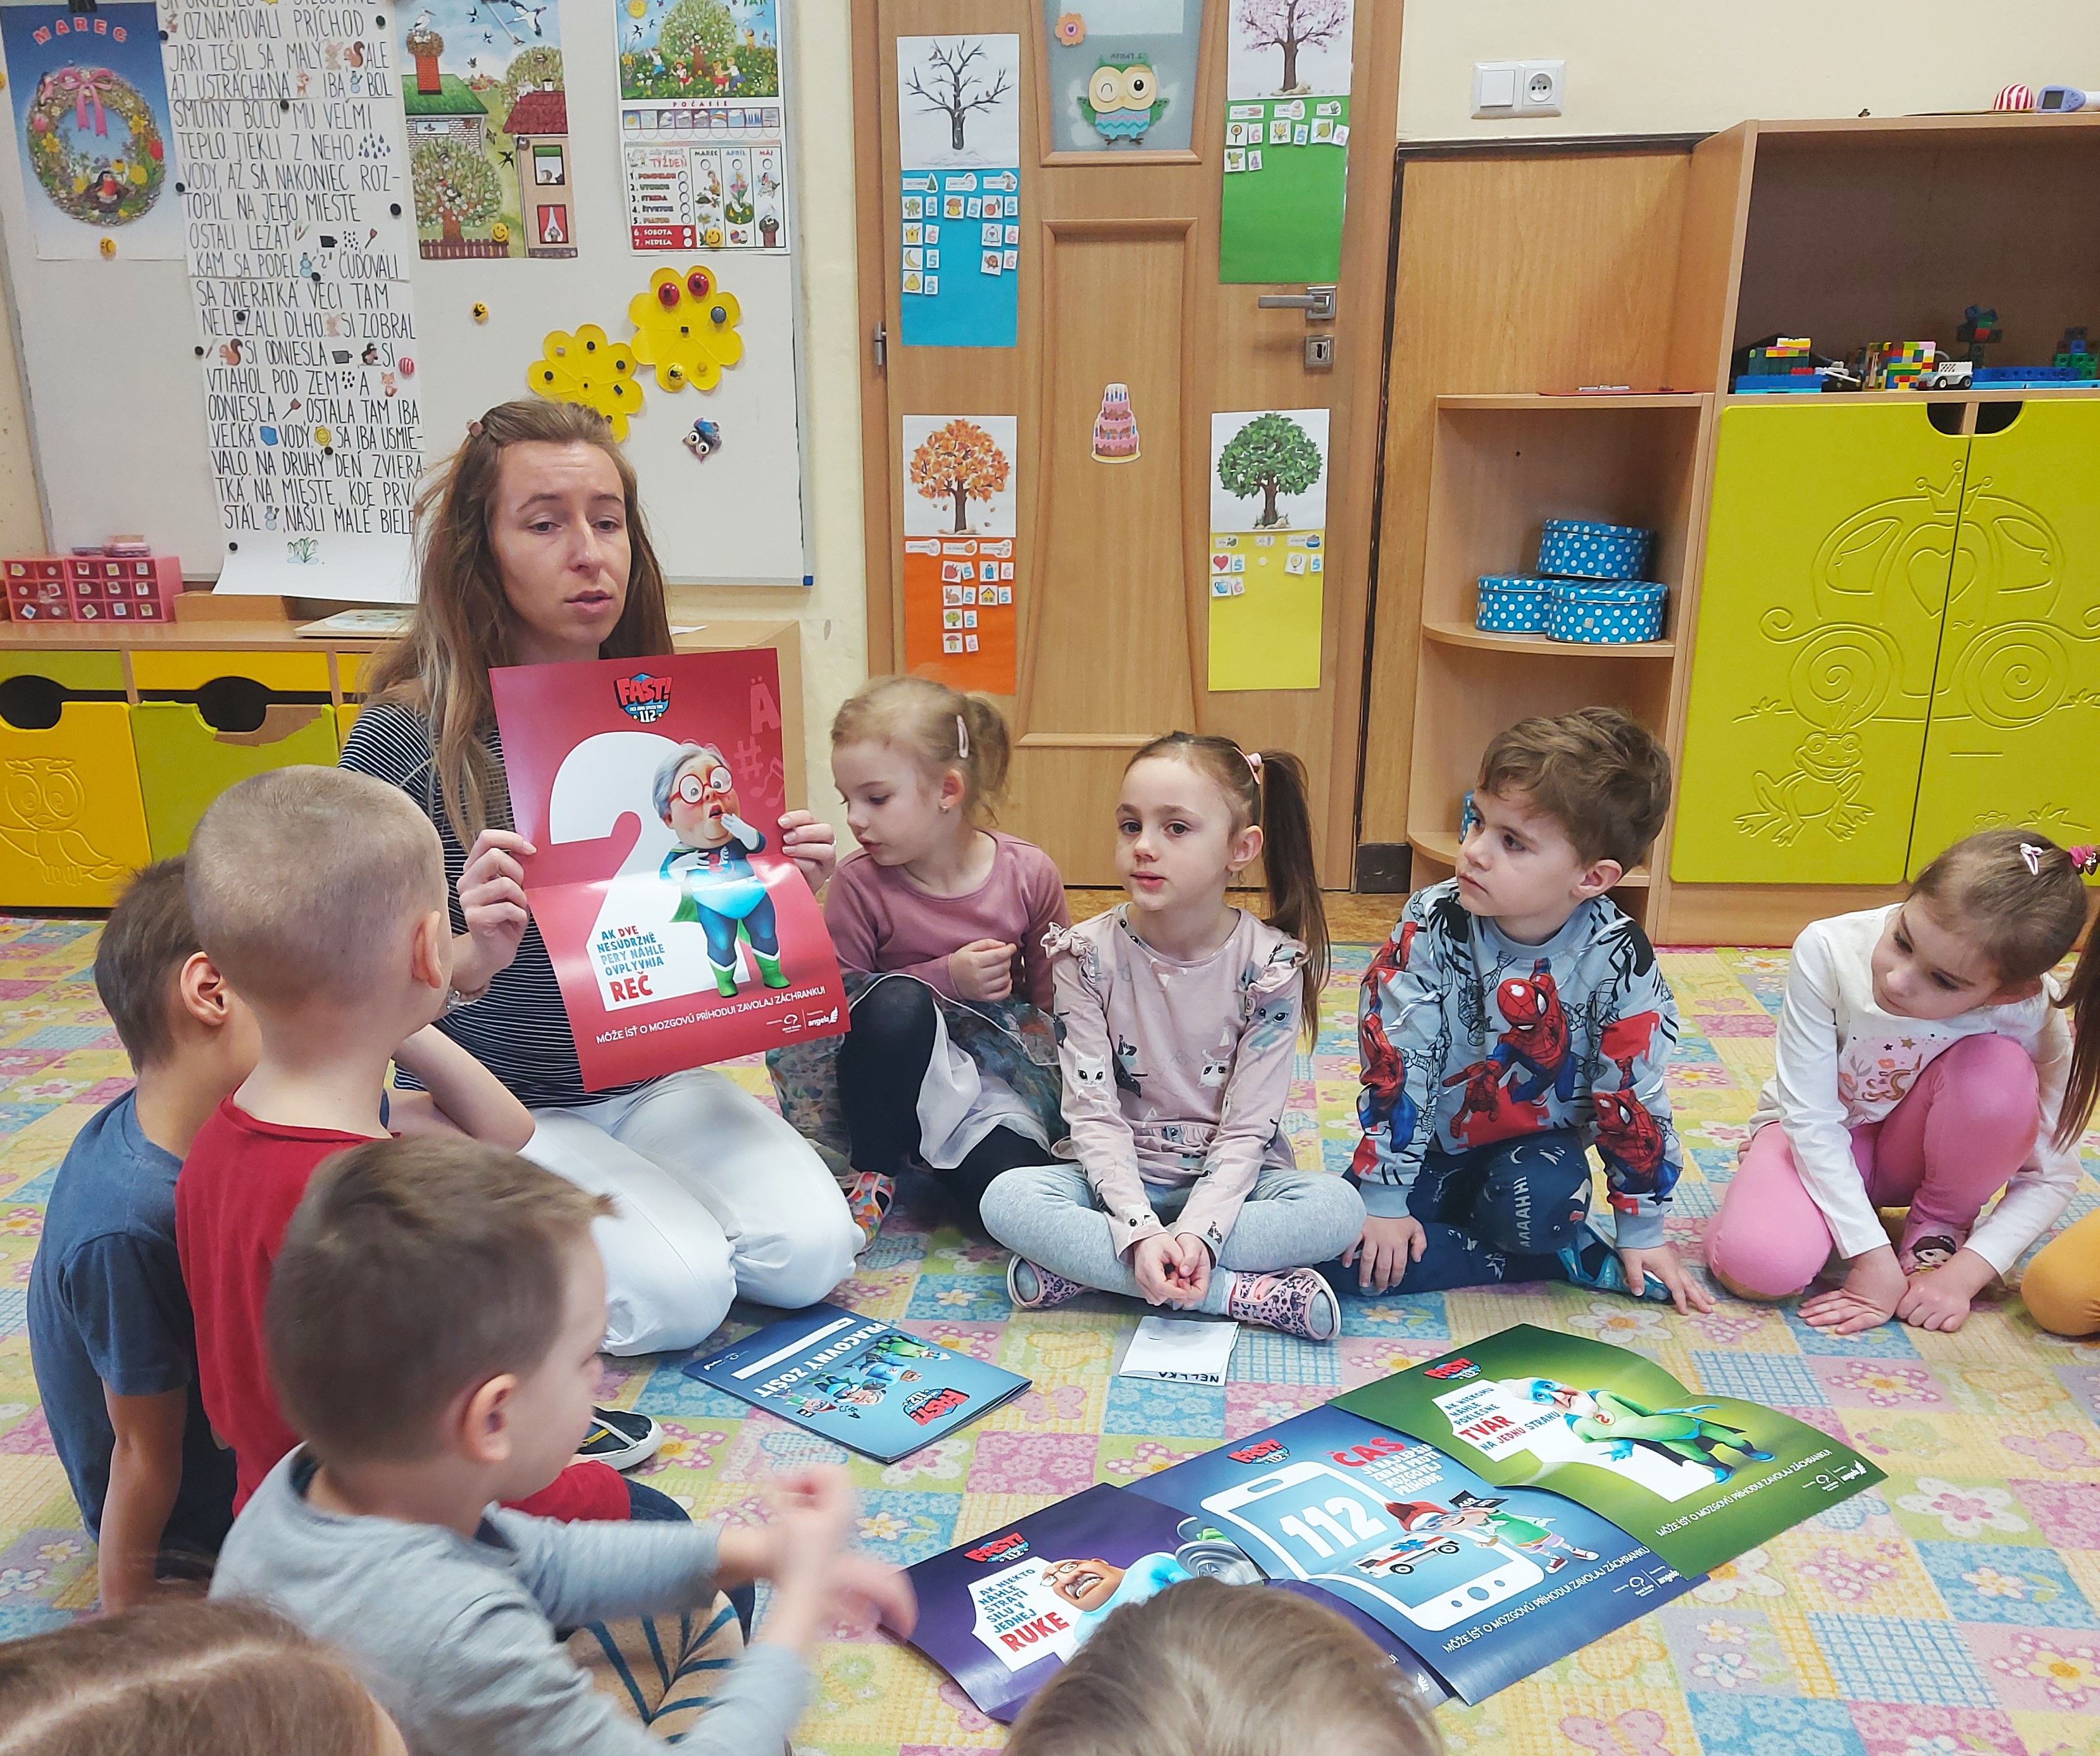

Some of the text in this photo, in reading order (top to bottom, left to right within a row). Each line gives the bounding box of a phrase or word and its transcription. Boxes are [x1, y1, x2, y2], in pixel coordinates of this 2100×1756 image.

[33, 16, 127, 45] MAREC
[184, 11, 282, 39] OZNAMOVALI
[208, 40, 252, 71] TEŠIL
[258, 44, 275, 69] SA
[171, 75, 187, 99] AJ
[323, 73, 345, 97] IBA
[367, 72, 393, 96] BOL
[293, 104, 316, 130] MU
[233, 132, 282, 159] TIEKLI
[290, 134, 302, 160] Z
[312, 134, 354, 161] NEHO
[228, 158, 247, 190] AŽ
[251, 163, 270, 190] SA
[275, 164, 349, 191] NAKONIEC
[360, 164, 401, 192] ROZ-
[237, 194, 257, 220] NA
[263, 194, 298, 222] JEHO
[306, 194, 361, 221] MIESTE
[189, 223, 236, 250] OSTALI
[234, 254, 251, 277] SA
[258, 254, 299, 278] PODEL
[196, 280, 390, 309] SA VECI TAM
[341, 312, 356, 338] SI
[359, 313, 416, 340] ZOBRAL
[245, 340, 395, 368] SI ODNIESLA SI
[207, 369, 370, 397] VTIAHOL POD ZEM A
[209, 395, 420, 425] ODNIESLA OSTALA TAM IBA
[336, 426, 349, 448] SA
[356, 426, 377, 450] IBA
[256, 451, 276, 476] NA
[284, 450, 325, 478] DRUHÝ
[254, 478, 275, 504] NA
[349, 481, 376, 507] KDE
[224, 503, 261, 530] STÁL
[335, 506, 371, 534] MALÉ
[963, 566, 972, 578] 5
[965, 591, 973, 602] 5
[966, 615, 974, 626] 5
[616, 676, 673, 707] FAST!
[639, 709, 657, 722] 112
[597, 932, 656, 953] NESÚDRŽNÉ
[602, 925, 638, 941] AK DVE
[600, 944, 665, 965] PERY NÁHLE
[606, 956, 664, 976] OVPLYVNIA
[609, 971, 653, 1002] REČ
[596, 1030, 624, 1044] MÔŽE
[640, 1025, 648, 1034] O
[649, 1012, 695, 1032] MOZGOVÚ
[737, 997, 773, 1013] ZAVOLAJ
[753, 1322, 890, 1398] PRACOVNÝ ZOŠIT
[910, 1388, 970, 1426] FAST!
[1456, 1387, 1494, 1405] NIEKOMU
[1458, 1416, 1516, 1440] TVÁR
[1479, 1411, 1561, 1451] NA JEDNU STRANU
[1325, 1437, 1407, 1468] ČAS
[1405, 1450, 1443, 1468] PROTI
[1361, 1463, 1380, 1475] JE
[1381, 1461, 1443, 1489] MOZGOVEJ
[1655, 1522, 1682, 1538] MÔŽE
[1689, 1512, 1699, 1522] O
[1698, 1495, 1734, 1518] MOZGOVÚ
[1764, 1468, 1794, 1487] ZAVOLAJ
[1277, 1497, 1389, 1559] 112
[979, 1569, 1036, 1596] AK NIEKTO
[986, 1607, 1015, 1623] SILU
[993, 1608, 1038, 1633] JEDNEJ
[1442, 1635, 1473, 1654] MÔŽE
[1482, 1623, 1493, 1634] O
[1493, 1601, 1536, 1629] MOZGOVÚ
[1569, 1569, 1606, 1590] ZAVOLAJ
[998, 1612, 1071, 1652] RUKE
